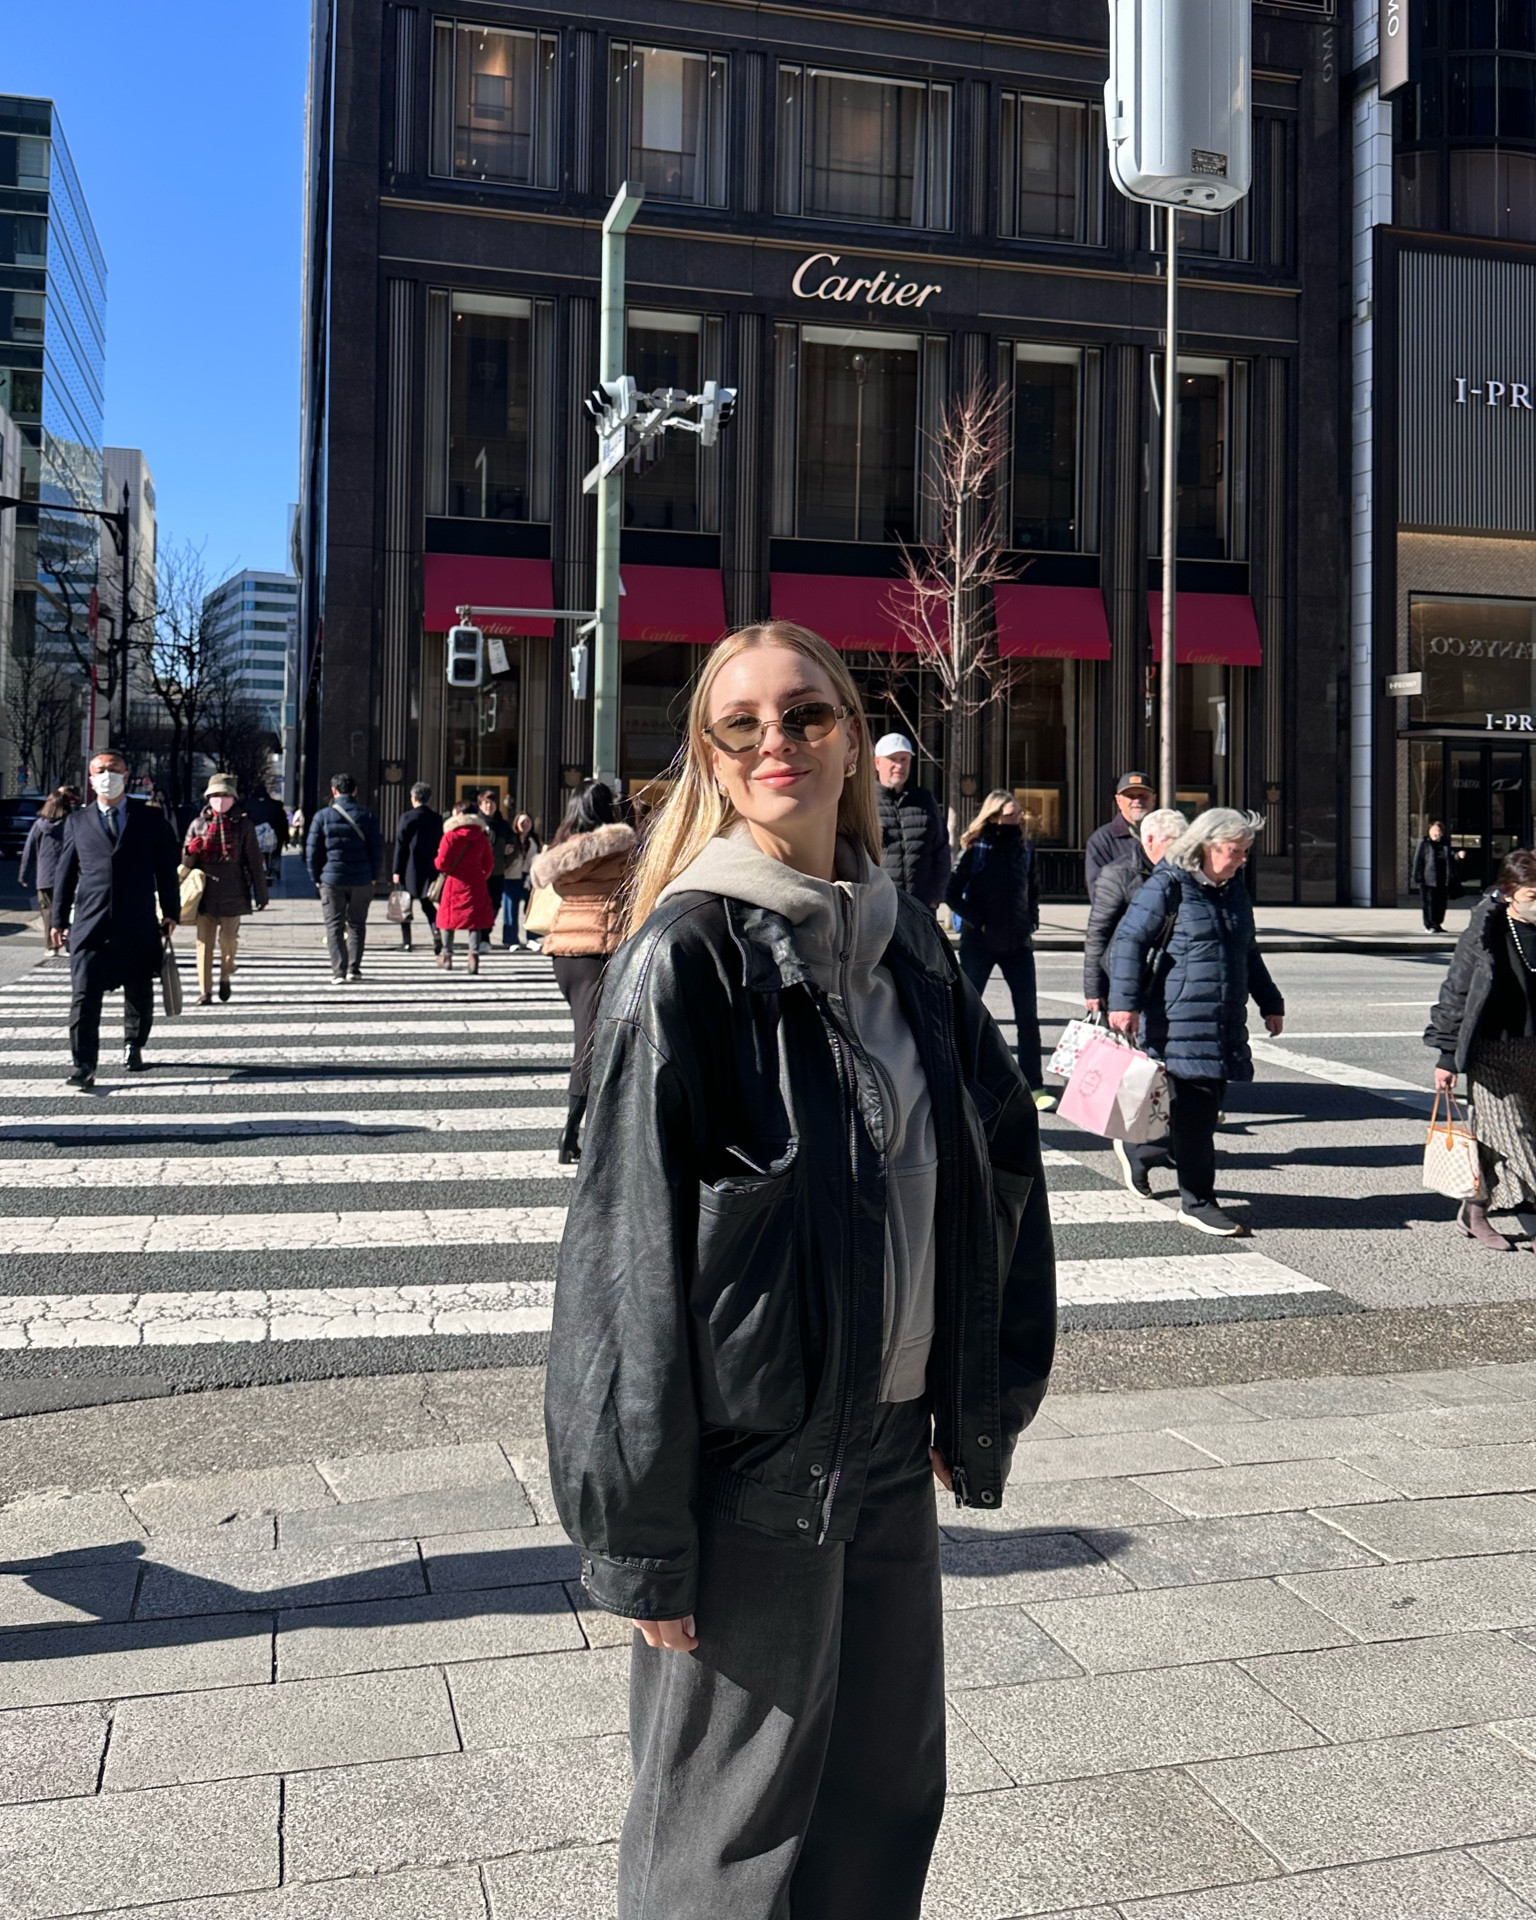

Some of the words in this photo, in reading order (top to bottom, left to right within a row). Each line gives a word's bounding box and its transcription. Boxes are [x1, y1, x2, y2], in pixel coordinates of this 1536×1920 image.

[792, 253, 942, 307] Cartier
[1455, 377, 1534, 409] I-PR
[641, 626, 689, 641] Cartier
[840, 634, 887, 650] Cartier
[1032, 644, 1077, 658] Cartier
[1186, 650, 1229, 664] Cartier
[1485, 713, 1536, 731] I-PR
